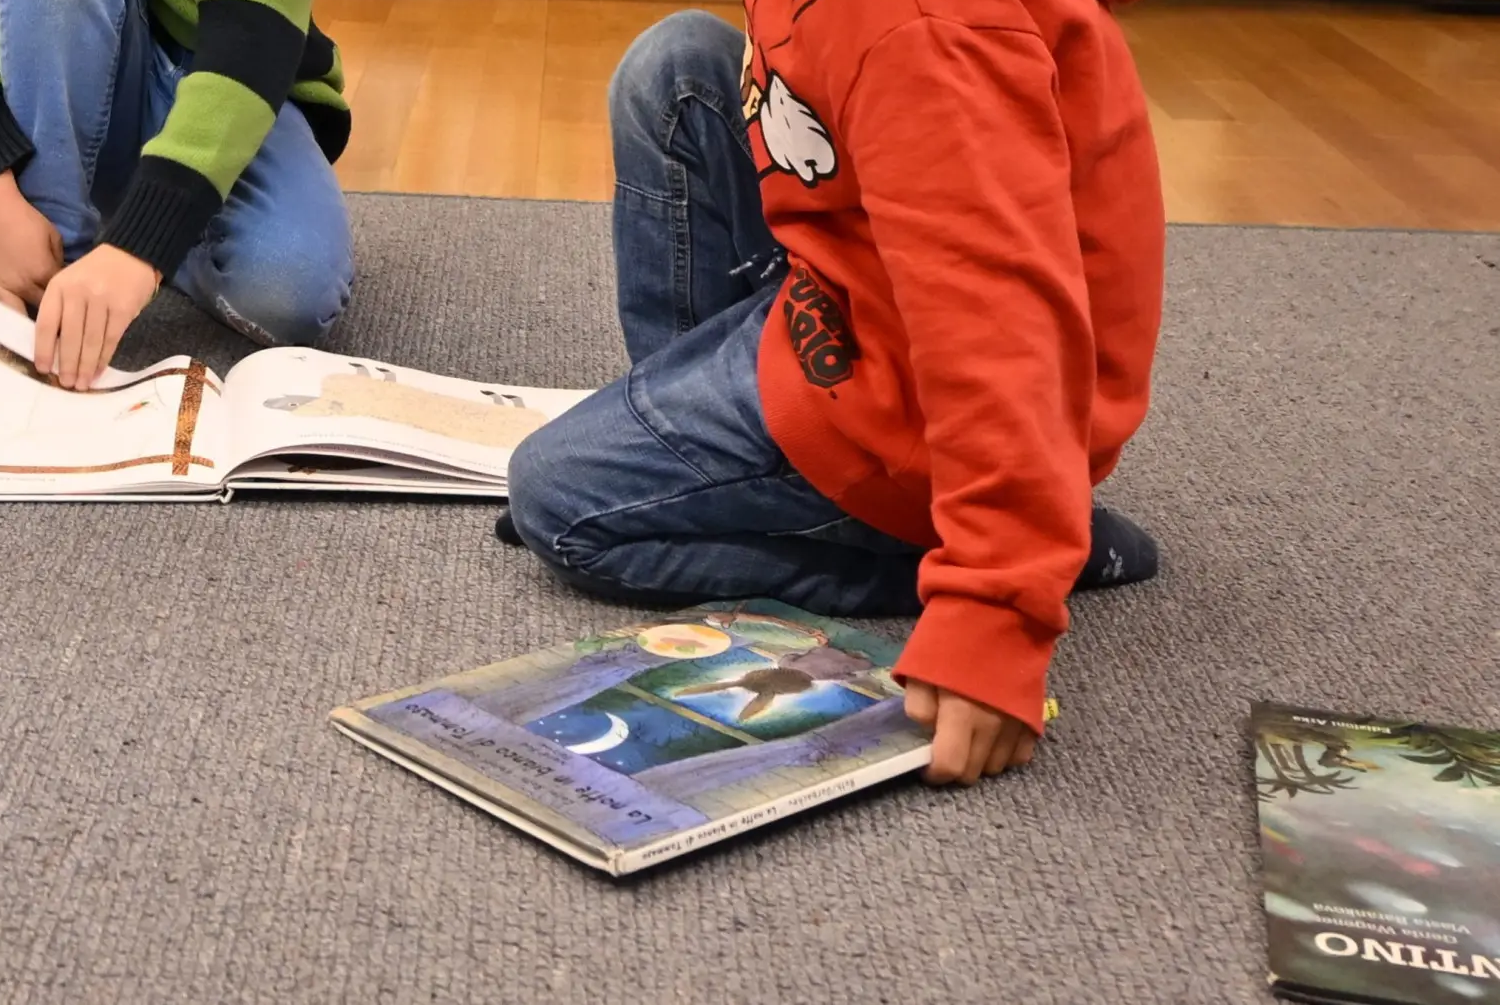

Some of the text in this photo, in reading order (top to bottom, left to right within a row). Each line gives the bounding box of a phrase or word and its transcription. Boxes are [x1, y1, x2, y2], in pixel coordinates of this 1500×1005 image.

[404, 703, 475, 740] Tommaso
[496, 747, 555, 776] bianco
[553, 775, 575, 786] in
[575, 786, 628, 811] notte
[628, 810, 653, 826] La
[745, 811, 764, 824] notte
[698, 824, 727, 840] bianco
[1414, 915, 1471, 935] Vlasta
